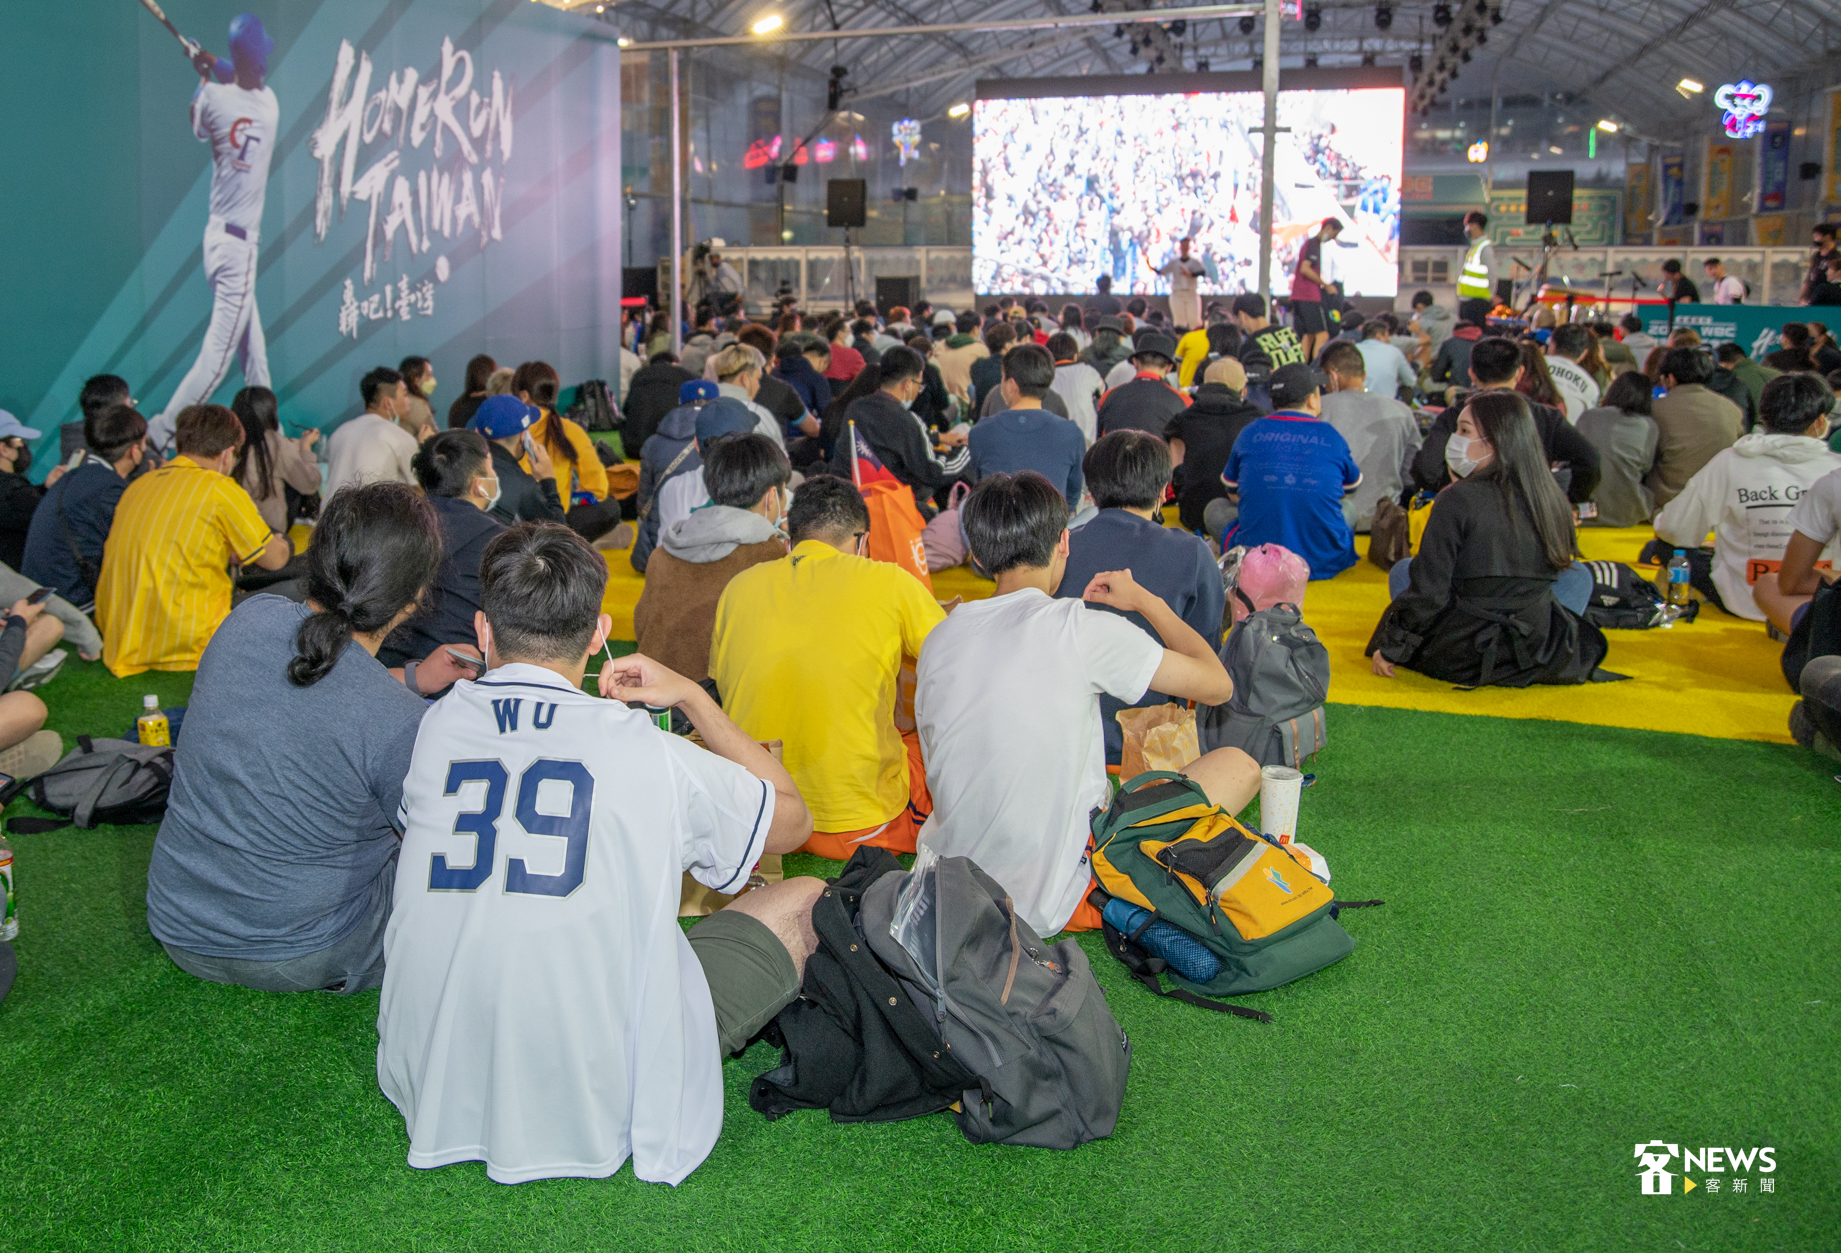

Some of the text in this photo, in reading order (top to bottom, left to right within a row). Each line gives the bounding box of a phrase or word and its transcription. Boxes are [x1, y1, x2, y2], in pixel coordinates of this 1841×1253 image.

[1701, 325, 1737, 338] WBC
[1548, 365, 1588, 394] OHOKU
[1737, 485, 1779, 503] Back
[490, 697, 559, 735] WU
[427, 756, 595, 901] 39
